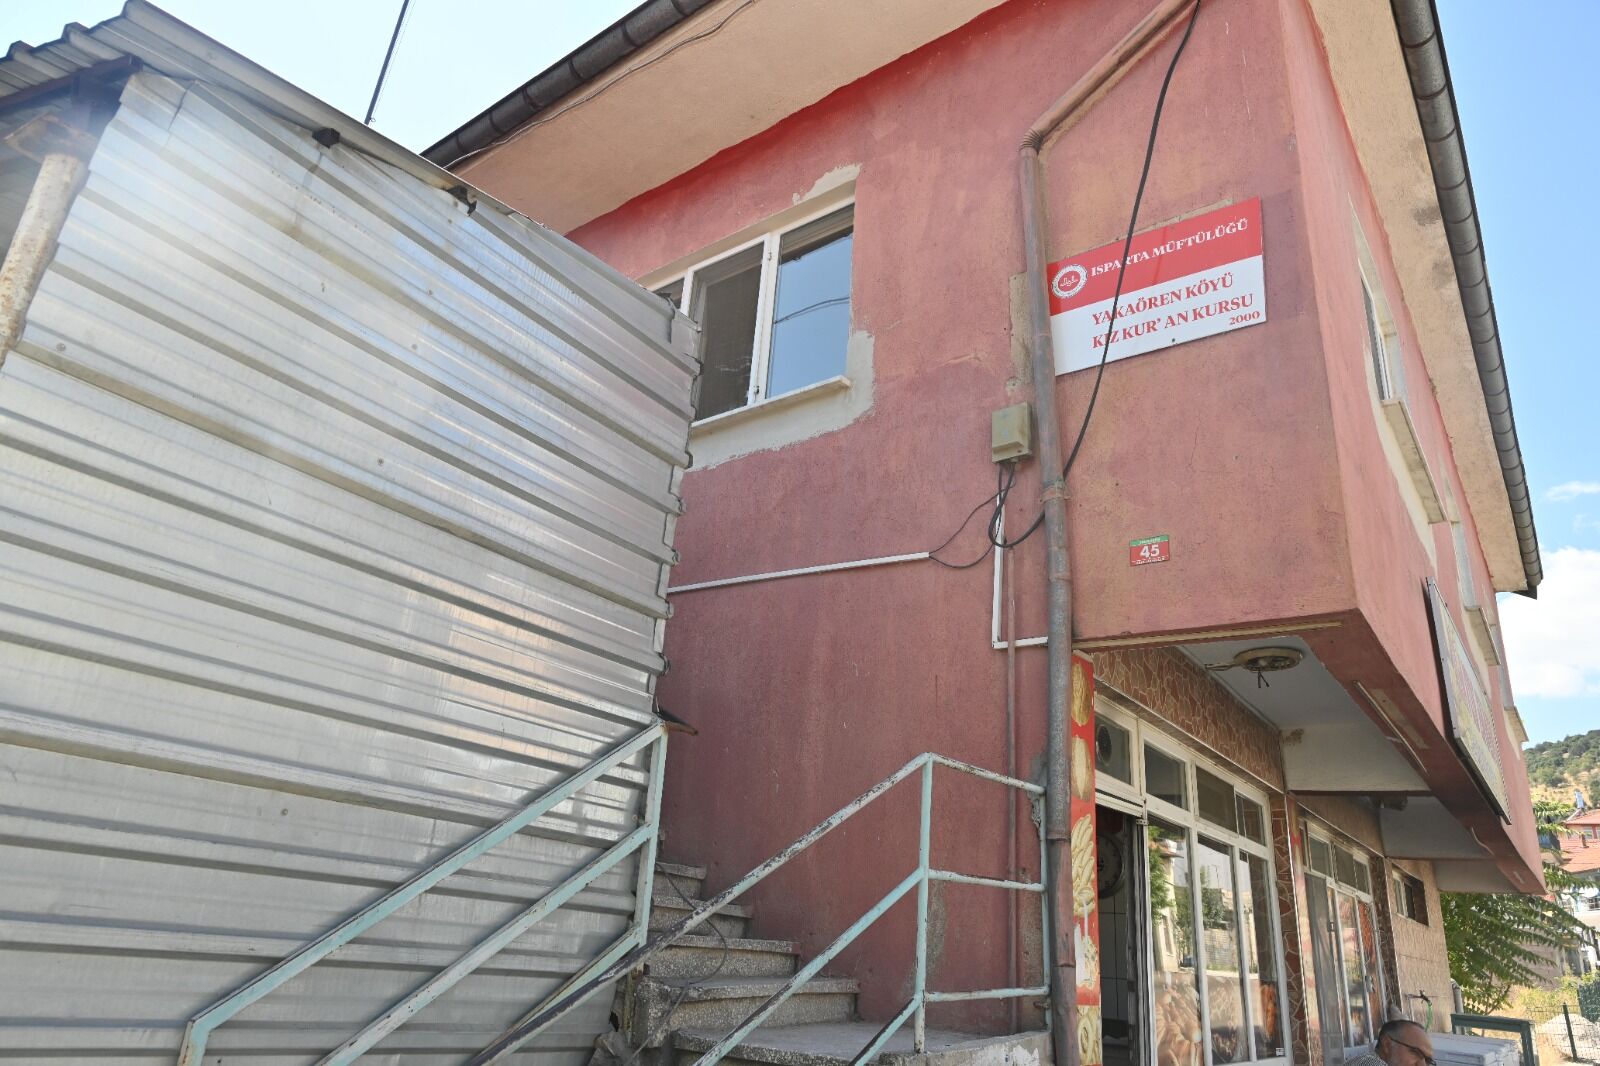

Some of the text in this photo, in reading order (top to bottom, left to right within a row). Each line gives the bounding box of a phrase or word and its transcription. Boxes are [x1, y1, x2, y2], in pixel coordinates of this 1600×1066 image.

[1092, 272, 1233, 325] YAKAÖREN KÖYÜ
[1192, 293, 1253, 321] KURSU
[1229, 310, 1260, 325] 2000
[1140, 544, 1160, 557] 45
